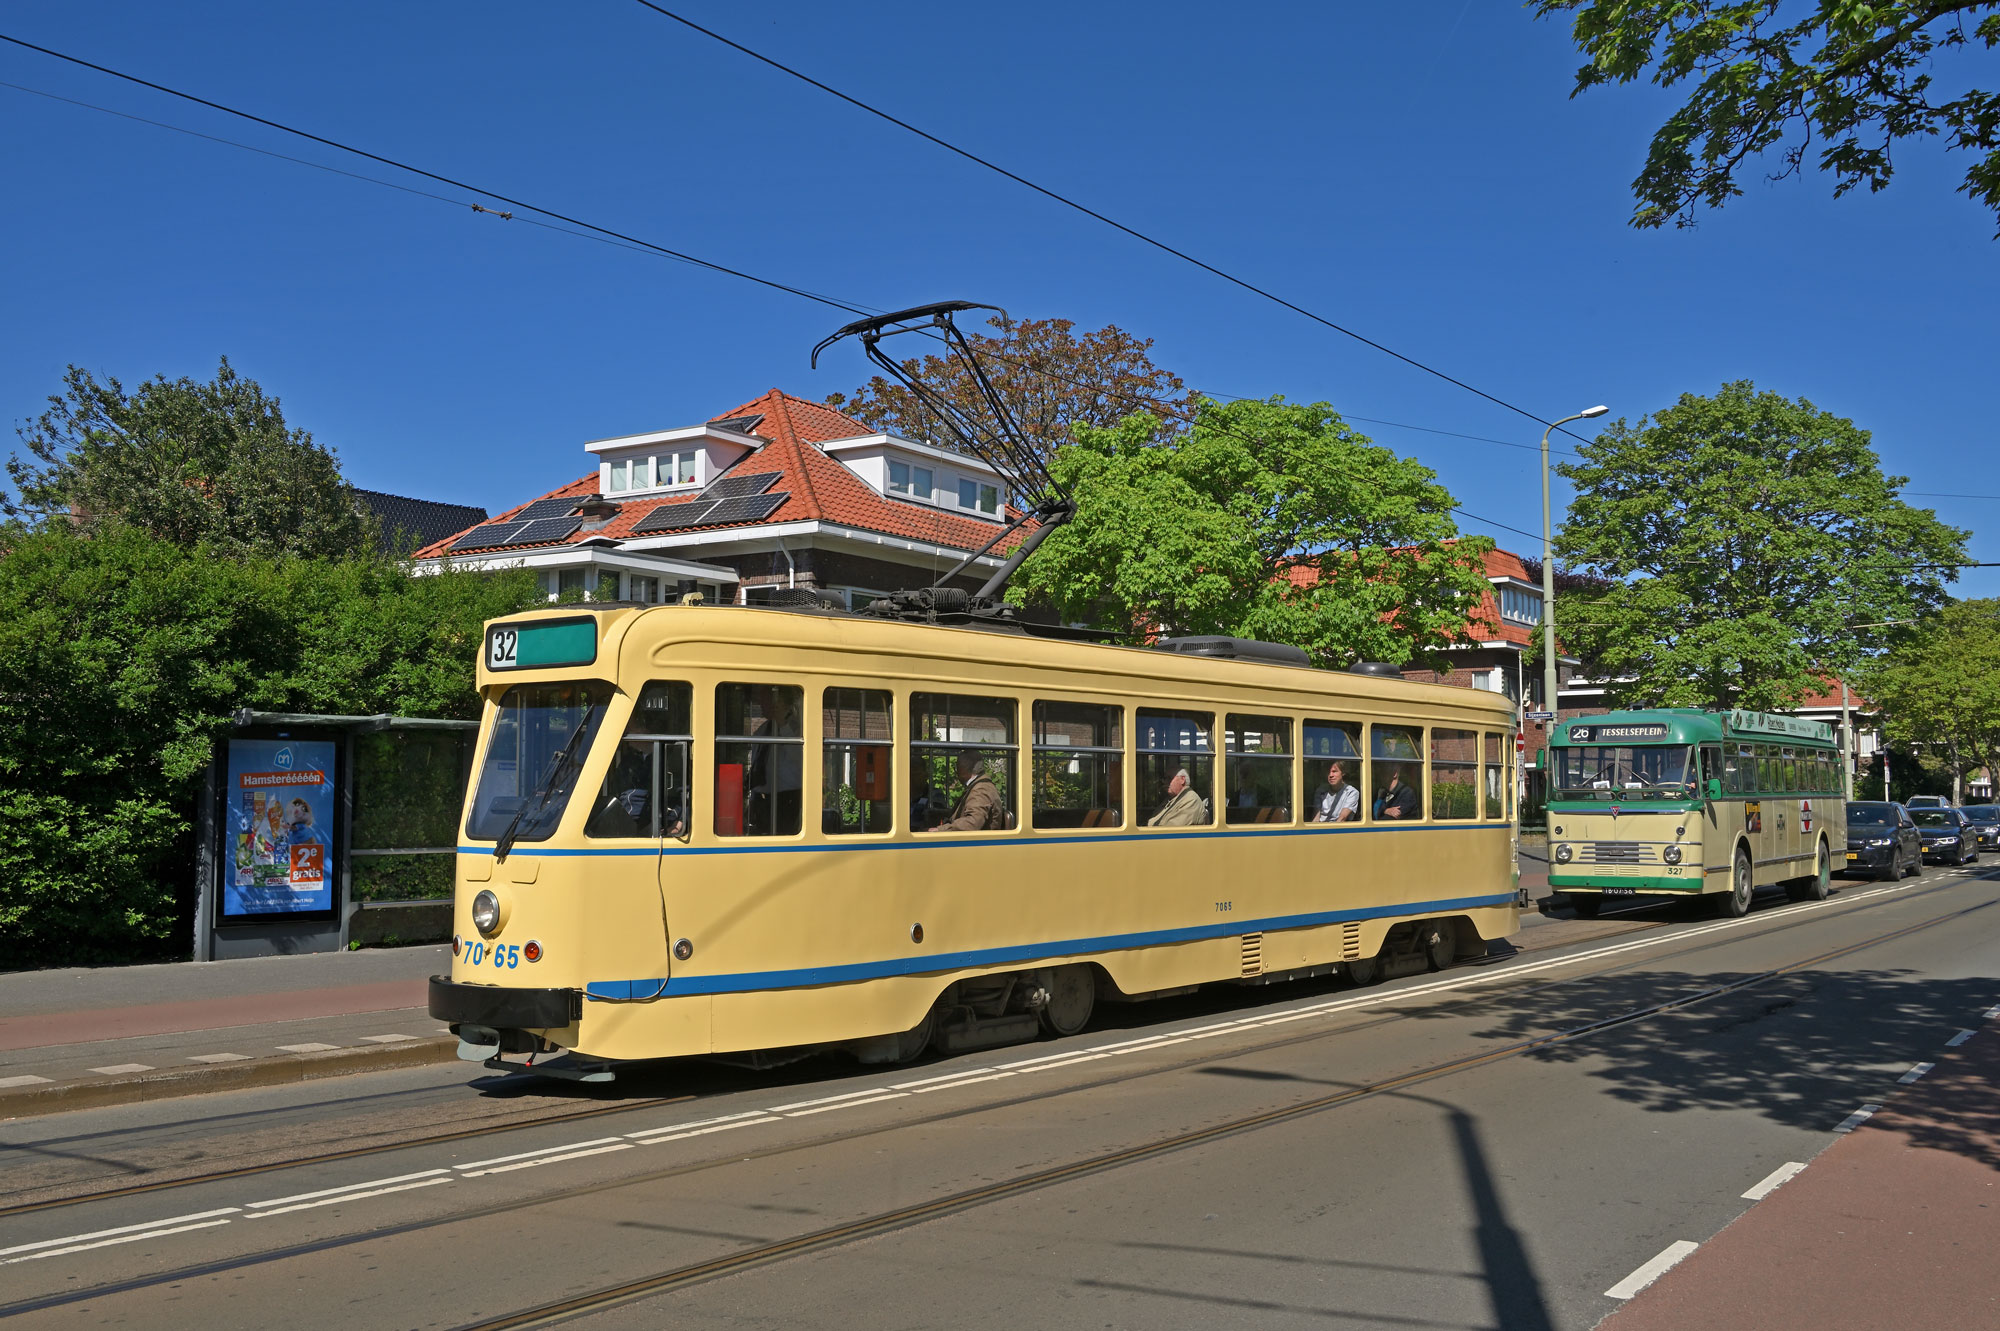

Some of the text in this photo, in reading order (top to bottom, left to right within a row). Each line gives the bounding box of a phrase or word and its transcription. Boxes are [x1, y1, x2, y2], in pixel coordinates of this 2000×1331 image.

[494, 630, 517, 662] 32
[1573, 727, 1663, 739] 26 TESSELSEPLEIN
[292, 868, 321, 881] gratis
[1667, 867, 1683, 876] 327
[1215, 901, 1232, 912] 7065
[463, 940, 520, 970] 70 65
